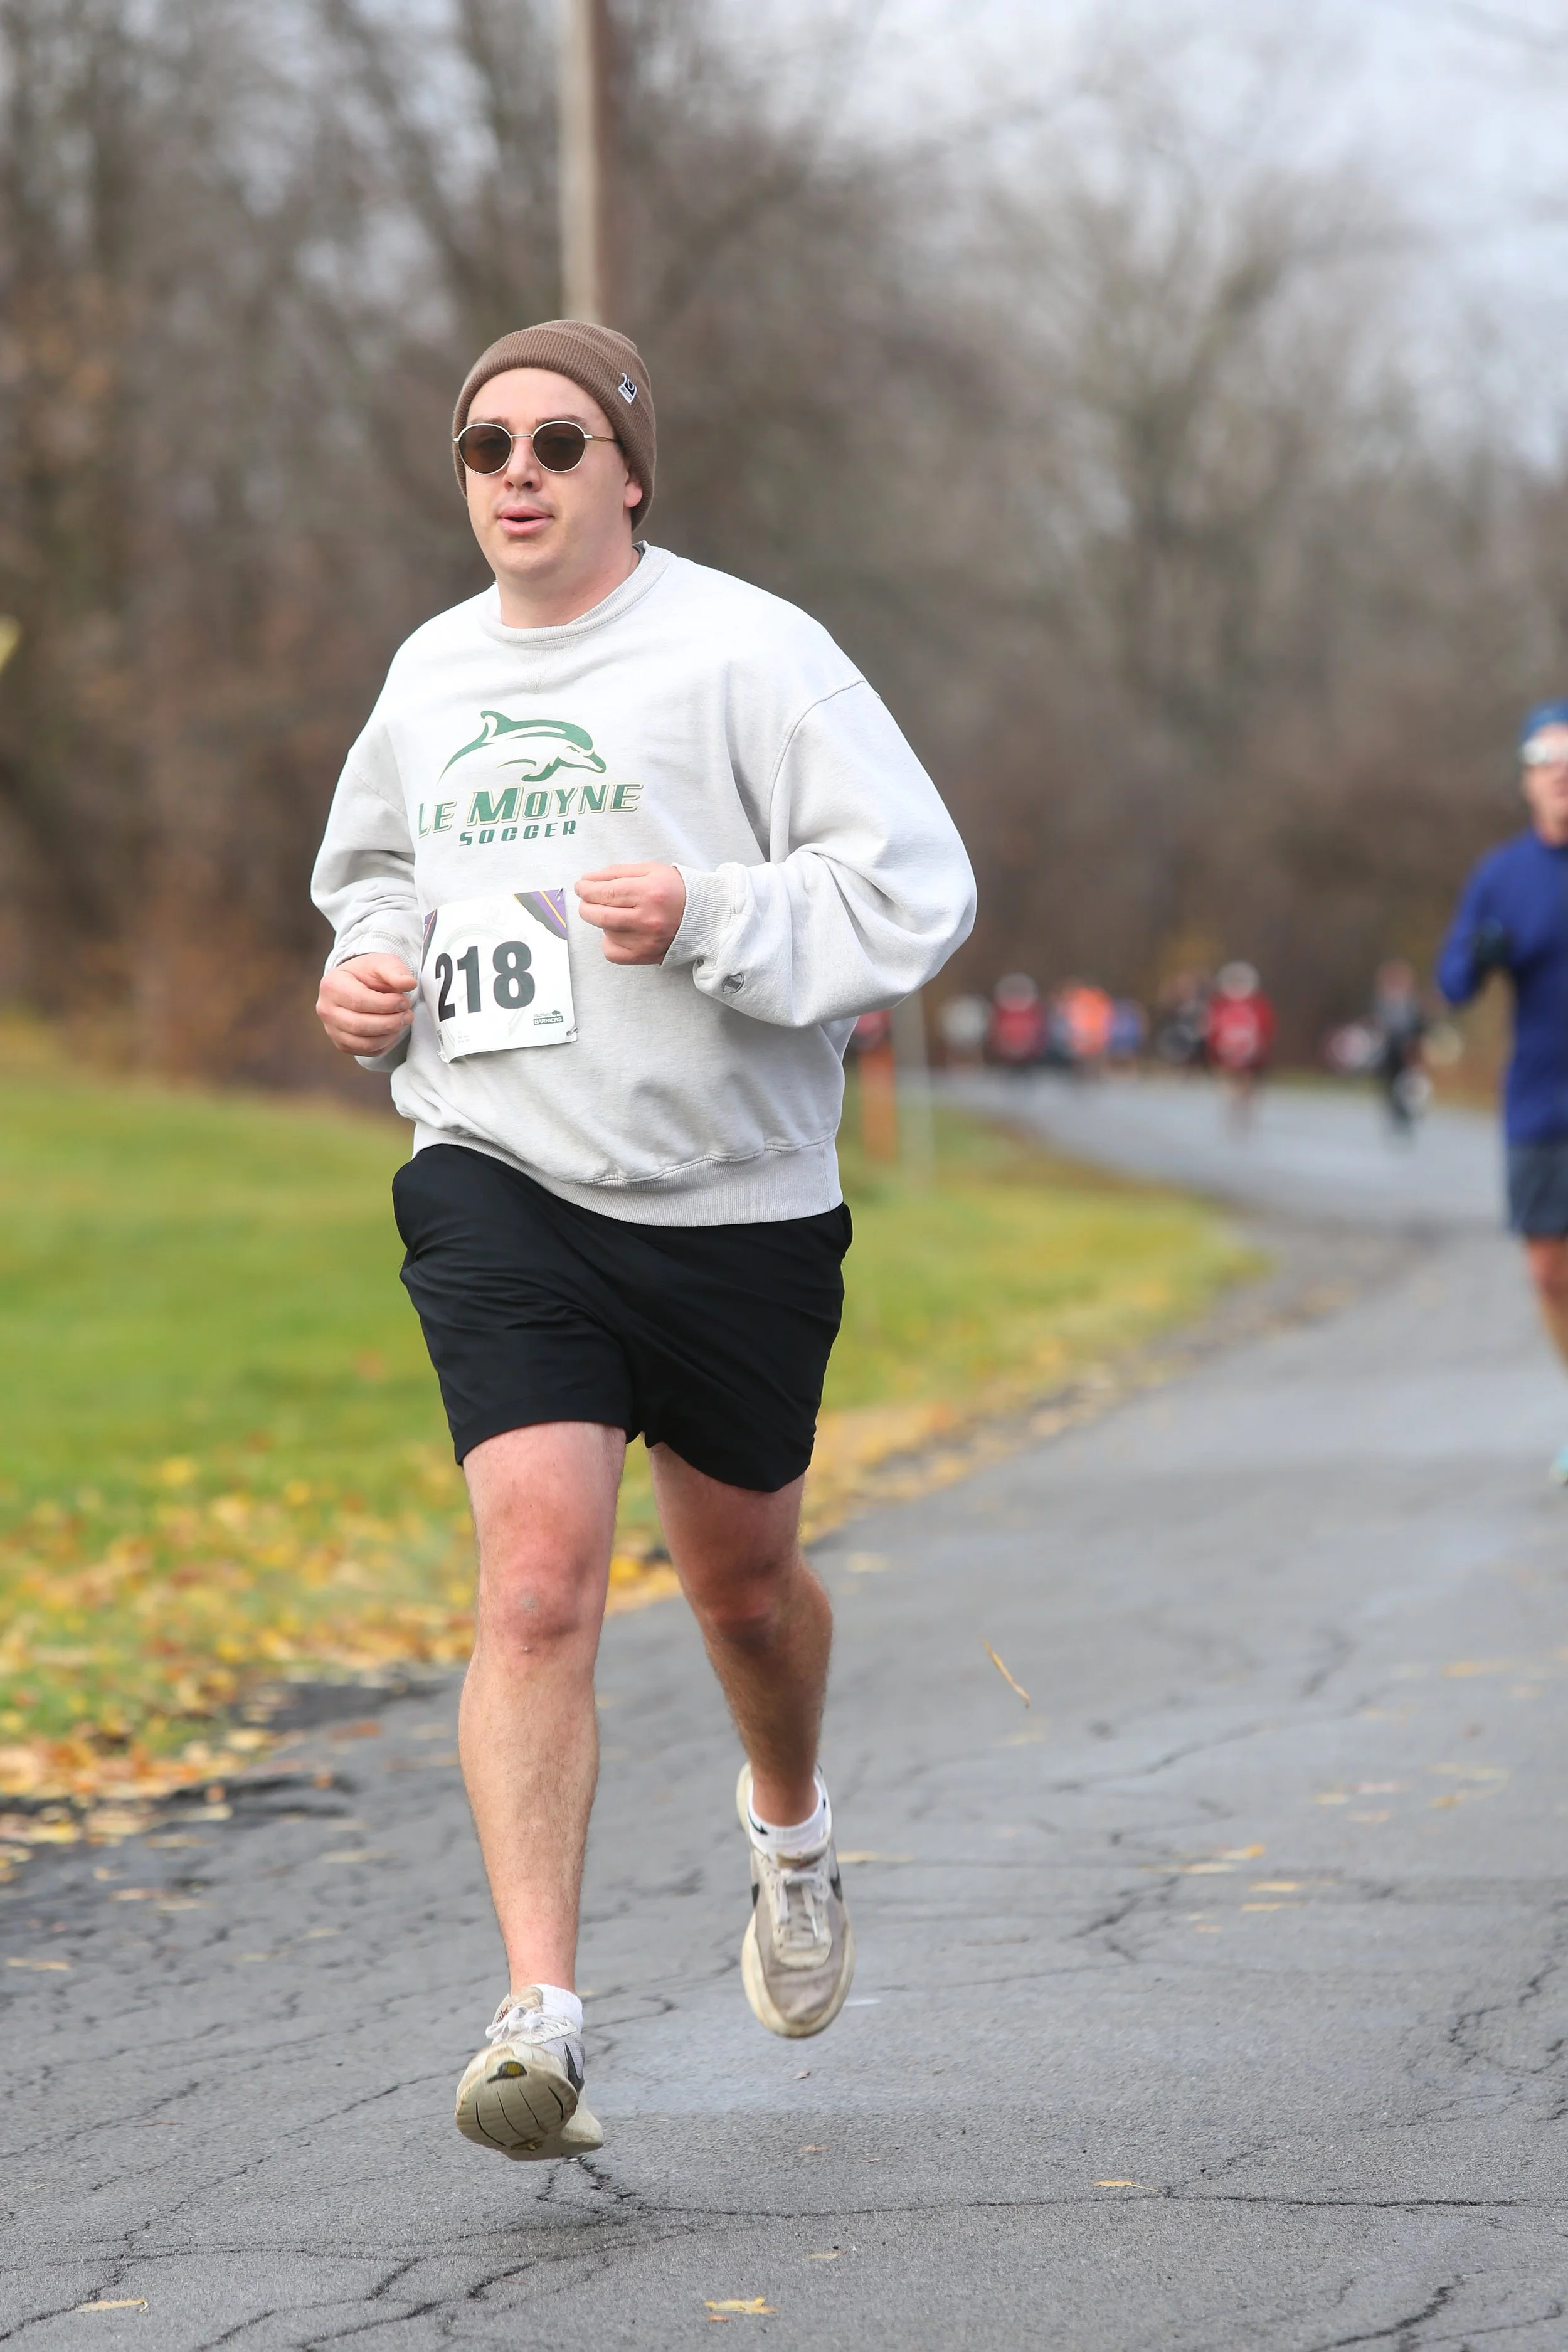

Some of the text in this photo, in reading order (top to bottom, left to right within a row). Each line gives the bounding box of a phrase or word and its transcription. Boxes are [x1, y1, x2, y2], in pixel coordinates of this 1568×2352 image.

[418, 782, 644, 838] LE MOYNE
[459, 820, 576, 846] SOCCER
[435, 941, 536, 1022] 218
